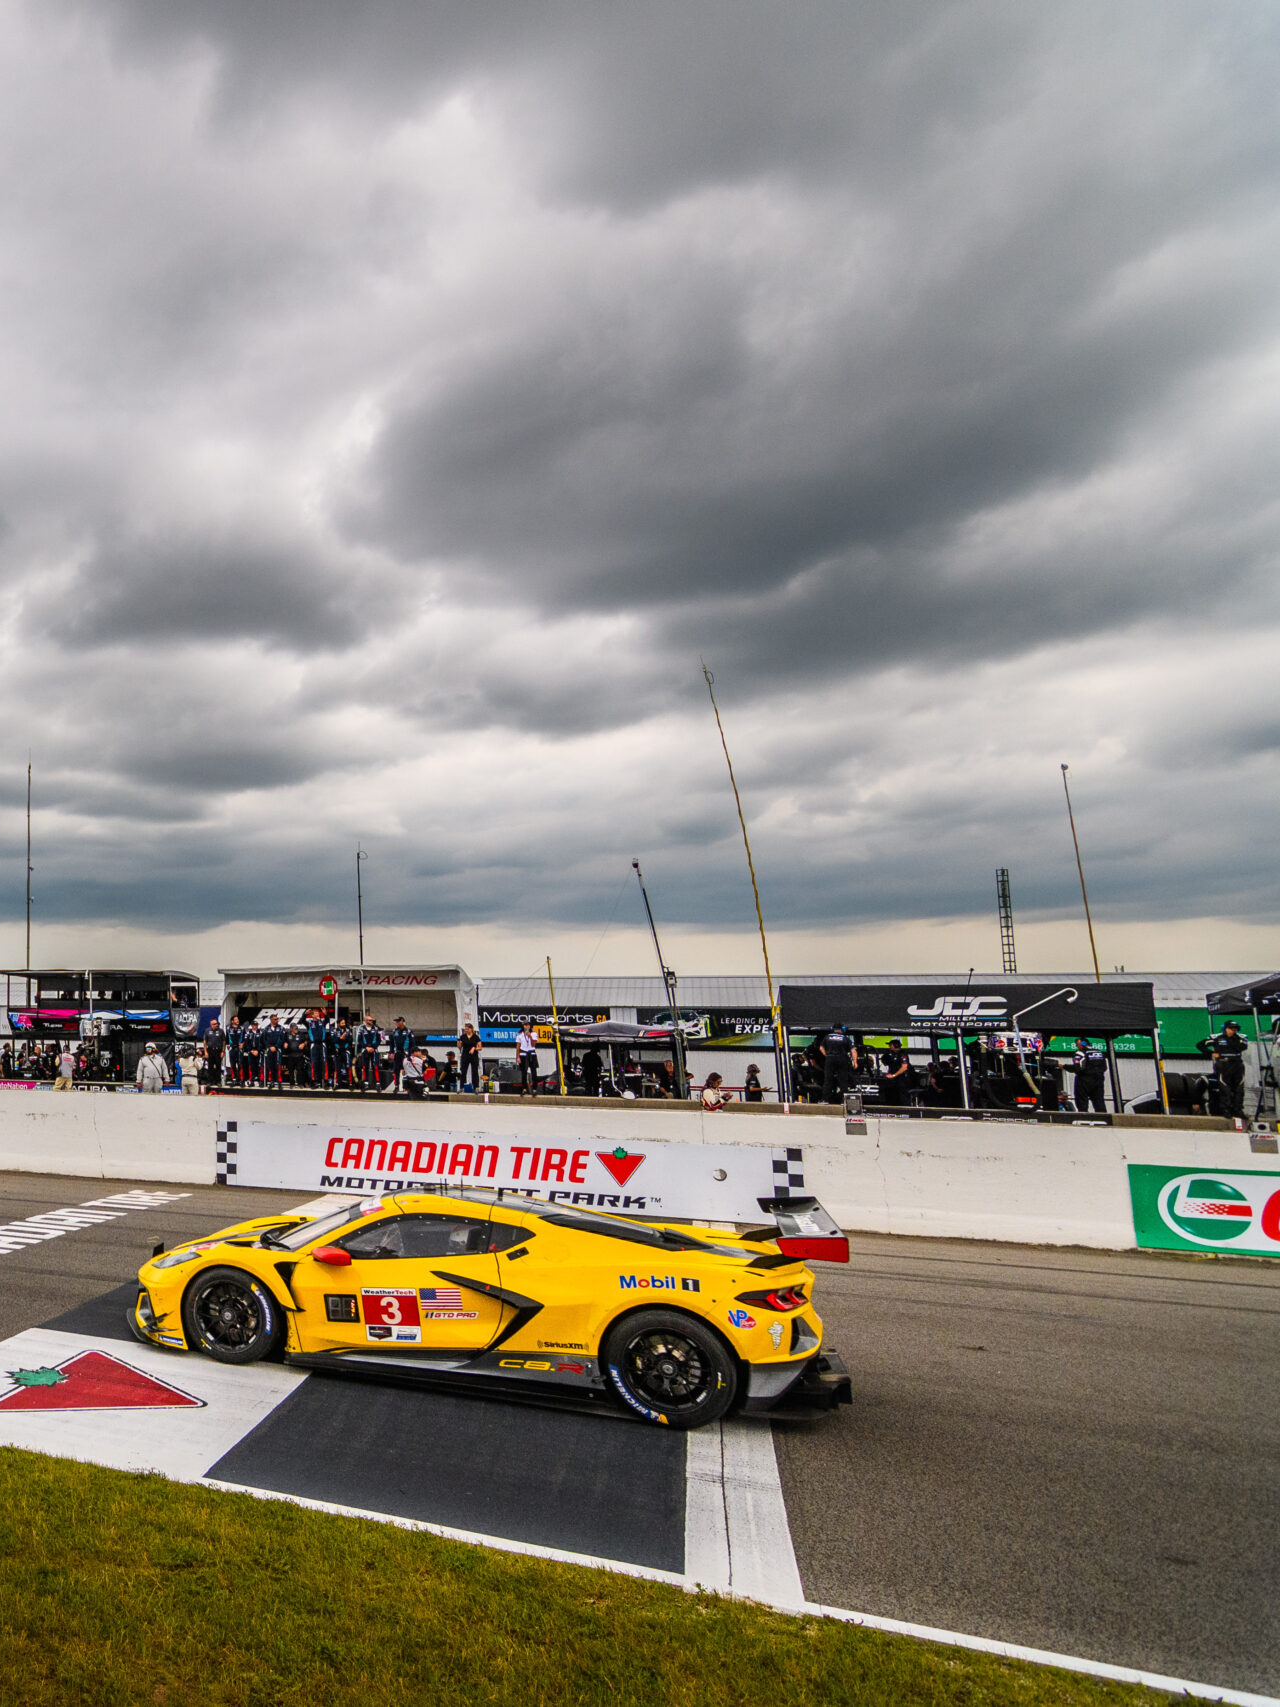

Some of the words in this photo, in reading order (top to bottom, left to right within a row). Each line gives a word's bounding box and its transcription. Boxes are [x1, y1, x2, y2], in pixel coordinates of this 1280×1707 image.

[366, 975, 438, 985] RACING
[907, 996, 1008, 1016] JDC
[538, 1029, 552, 1041] Lap
[324, 1137, 499, 1178] CANADIAN
[510, 1146, 590, 1184] TIRE
[80, 1190, 193, 1210] TIRE
[619, 1275, 676, 1290] Mobil
[380, 1296, 402, 1325] 3
[728, 1309, 748, 1328] VP
[499, 1359, 586, 1375] C8.R
[610, 1369, 649, 1416] MICHELIN
